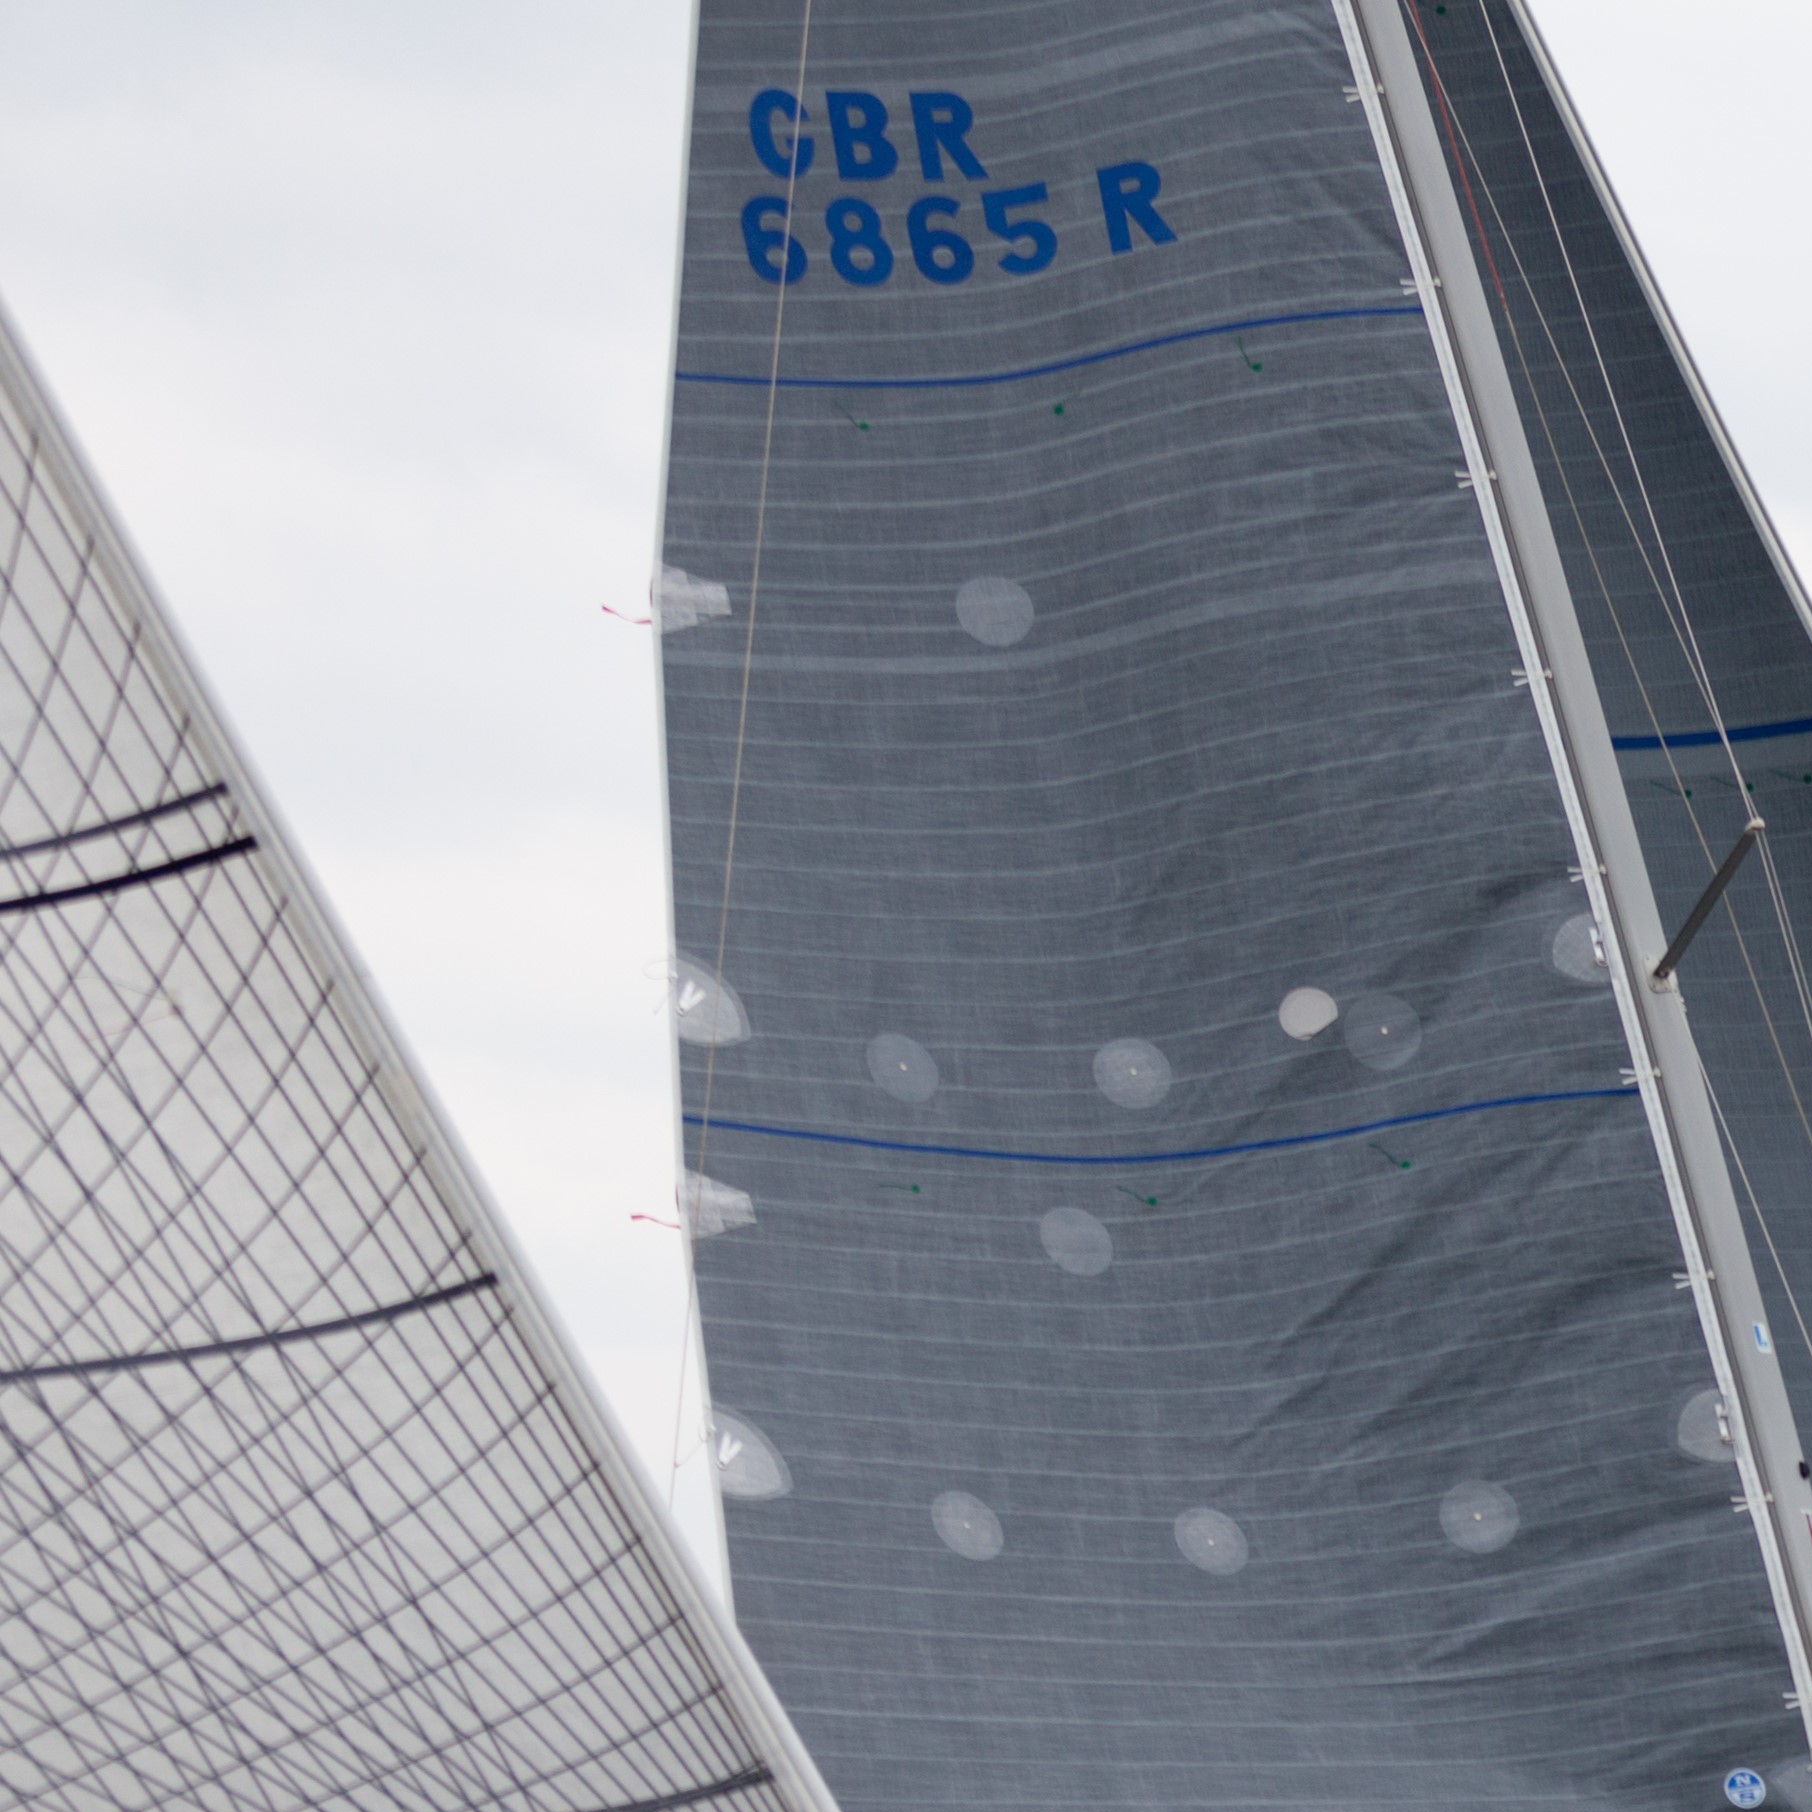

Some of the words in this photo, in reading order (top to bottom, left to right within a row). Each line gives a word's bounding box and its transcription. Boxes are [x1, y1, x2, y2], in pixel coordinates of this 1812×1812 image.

[748, 88, 990, 182] GBR
[740, 181, 1058, 287] 6865
[1096, 160, 1178, 255] R
